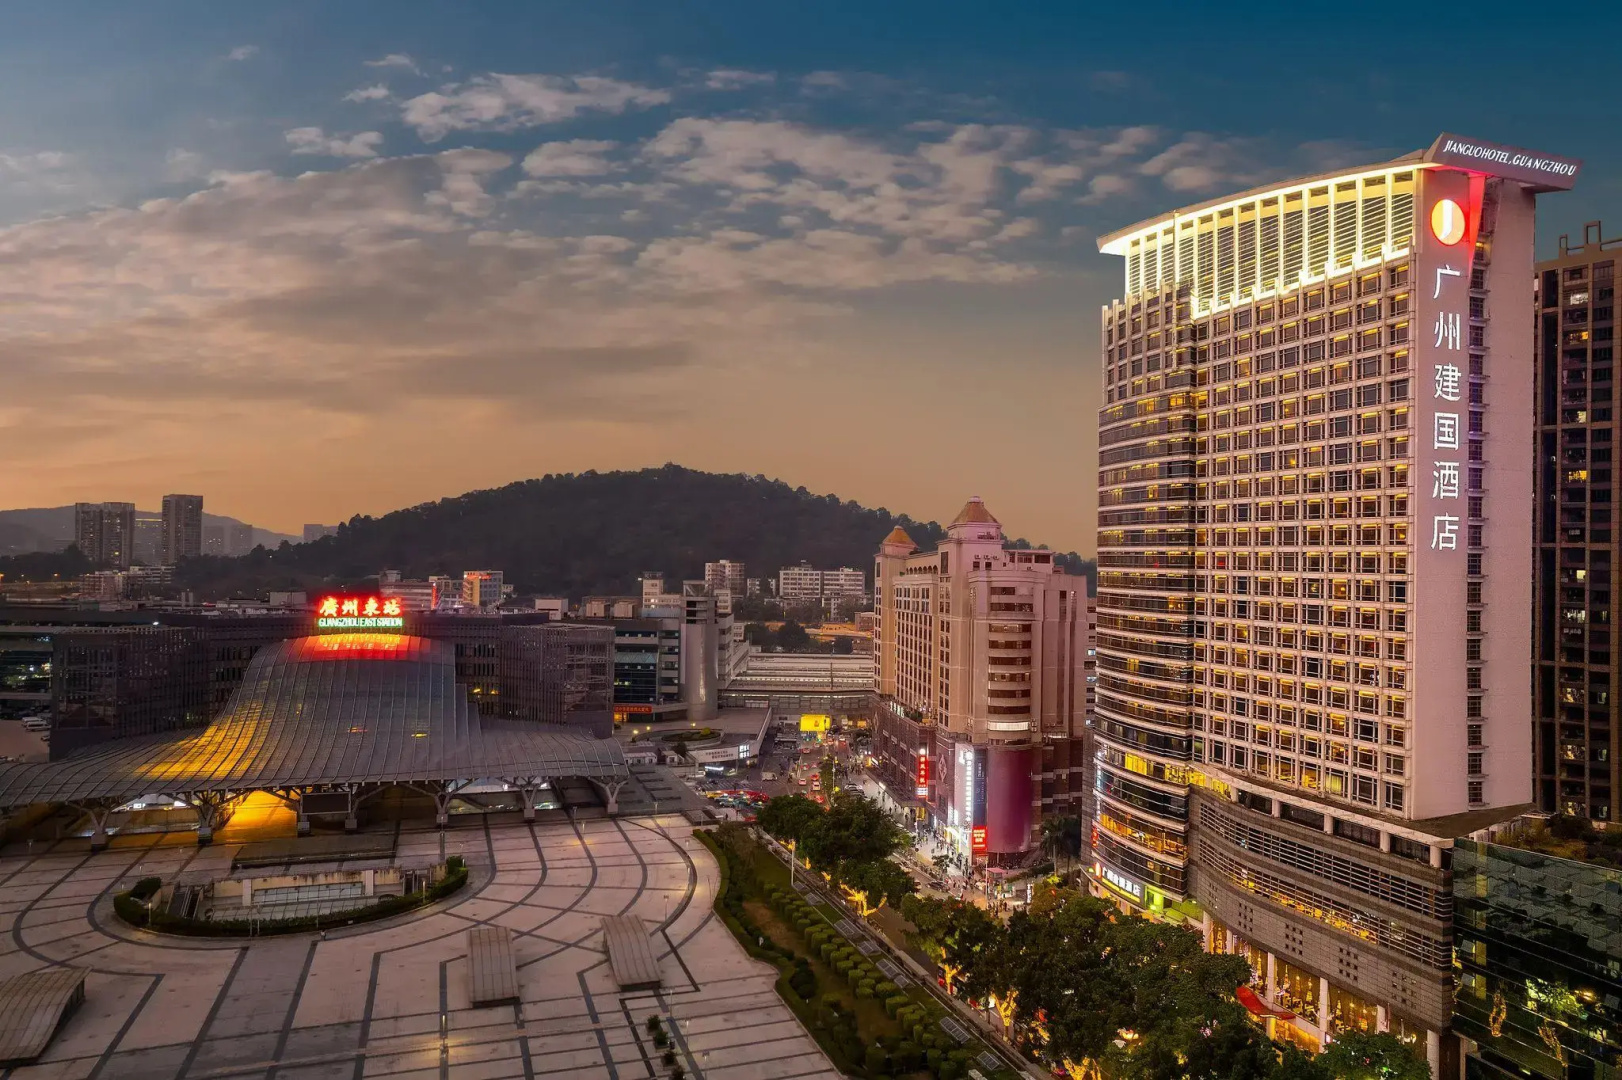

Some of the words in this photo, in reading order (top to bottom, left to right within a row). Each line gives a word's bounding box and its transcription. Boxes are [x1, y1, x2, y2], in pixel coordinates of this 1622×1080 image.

[1431, 264, 1461, 551] 广州建国酒店
[319, 596, 401, 617] 廣州東站
[1102, 866, 1141, 897] 广酒店
